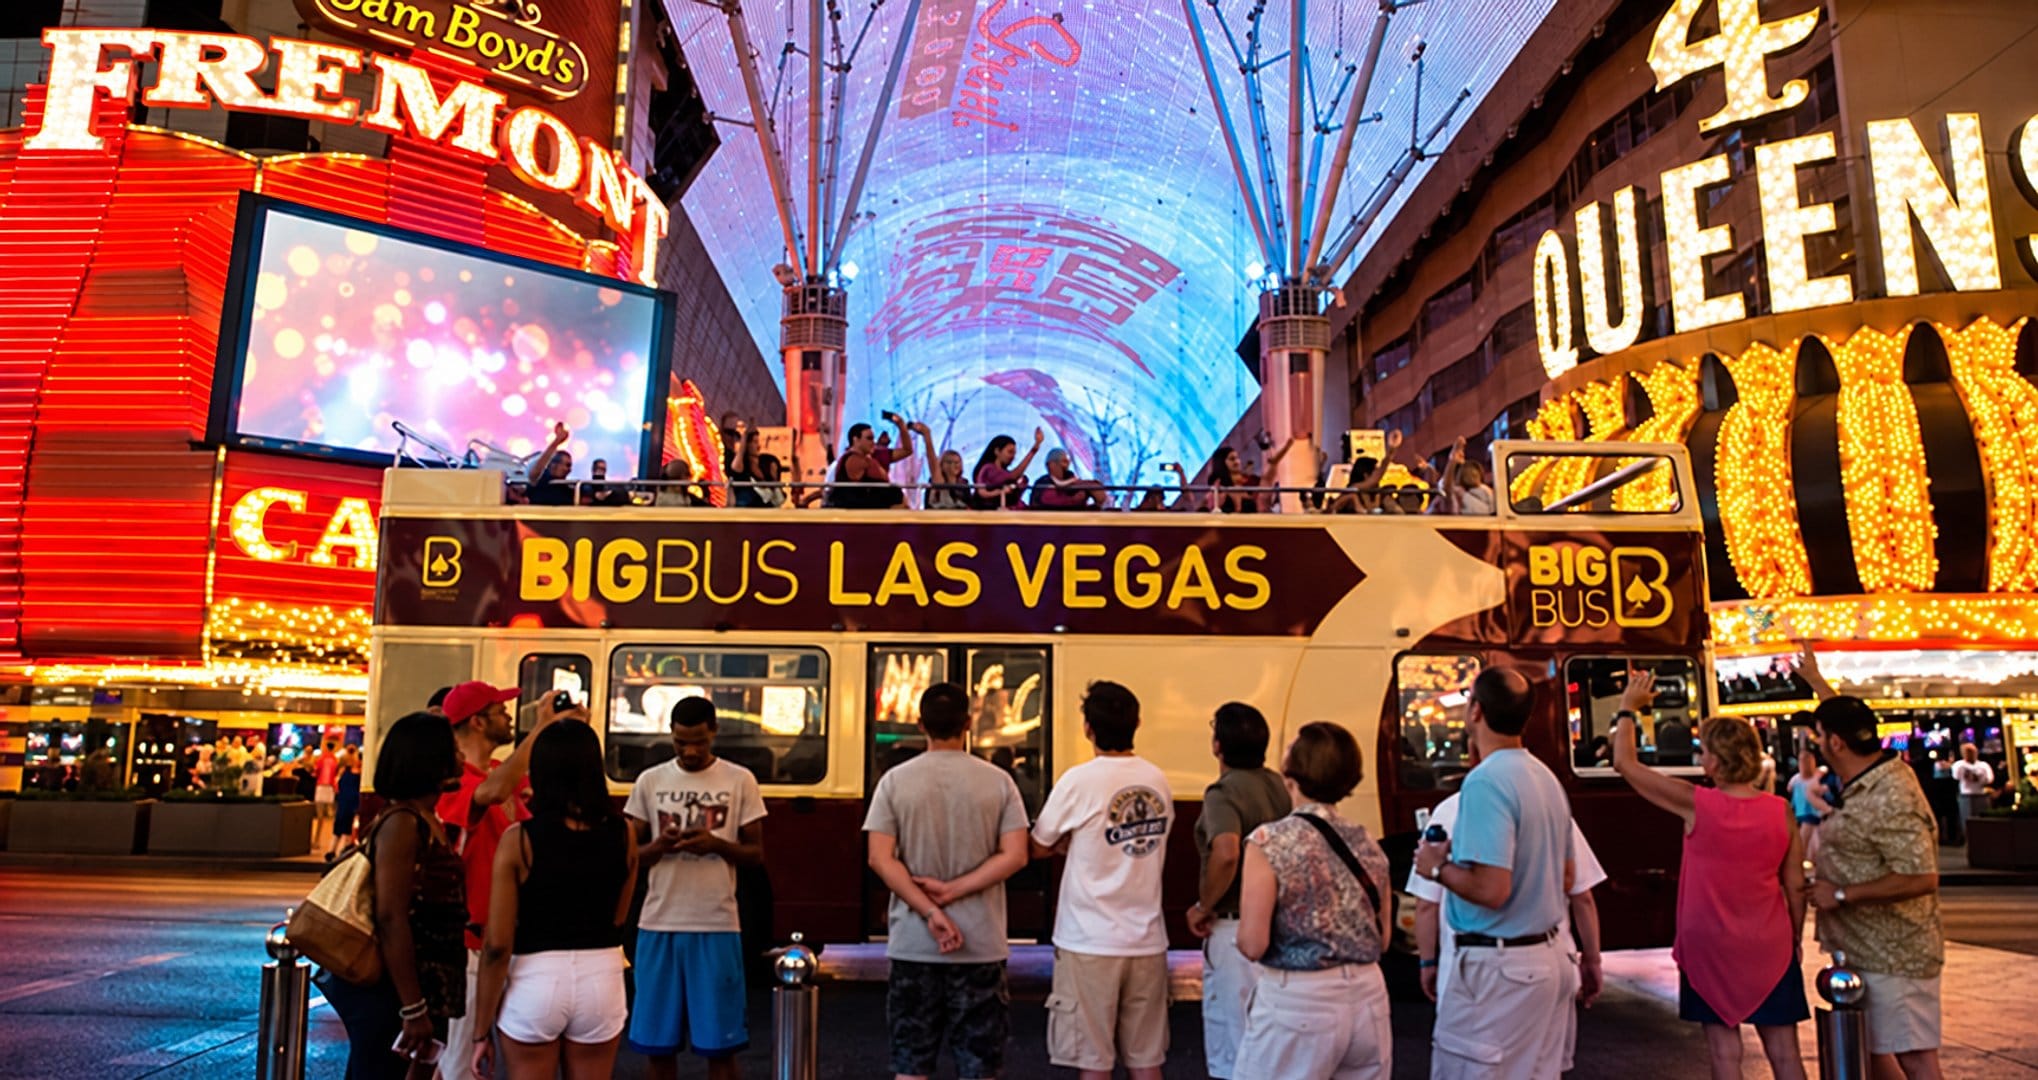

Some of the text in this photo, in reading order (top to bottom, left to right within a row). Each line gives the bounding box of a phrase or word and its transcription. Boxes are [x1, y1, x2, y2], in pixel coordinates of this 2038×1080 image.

[442, 4, 576, 84] Boyd's
[1647, 0, 1820, 134] 4
[22, 27, 669, 288] FREMONT
[1533, 112, 2038, 380] QUEEN
[829, 541, 982, 608] LAS
[1006, 542, 1272, 611] VEGAS
[1529, 545, 1608, 586] BIG
[1531, 589, 1610, 628] BUS
